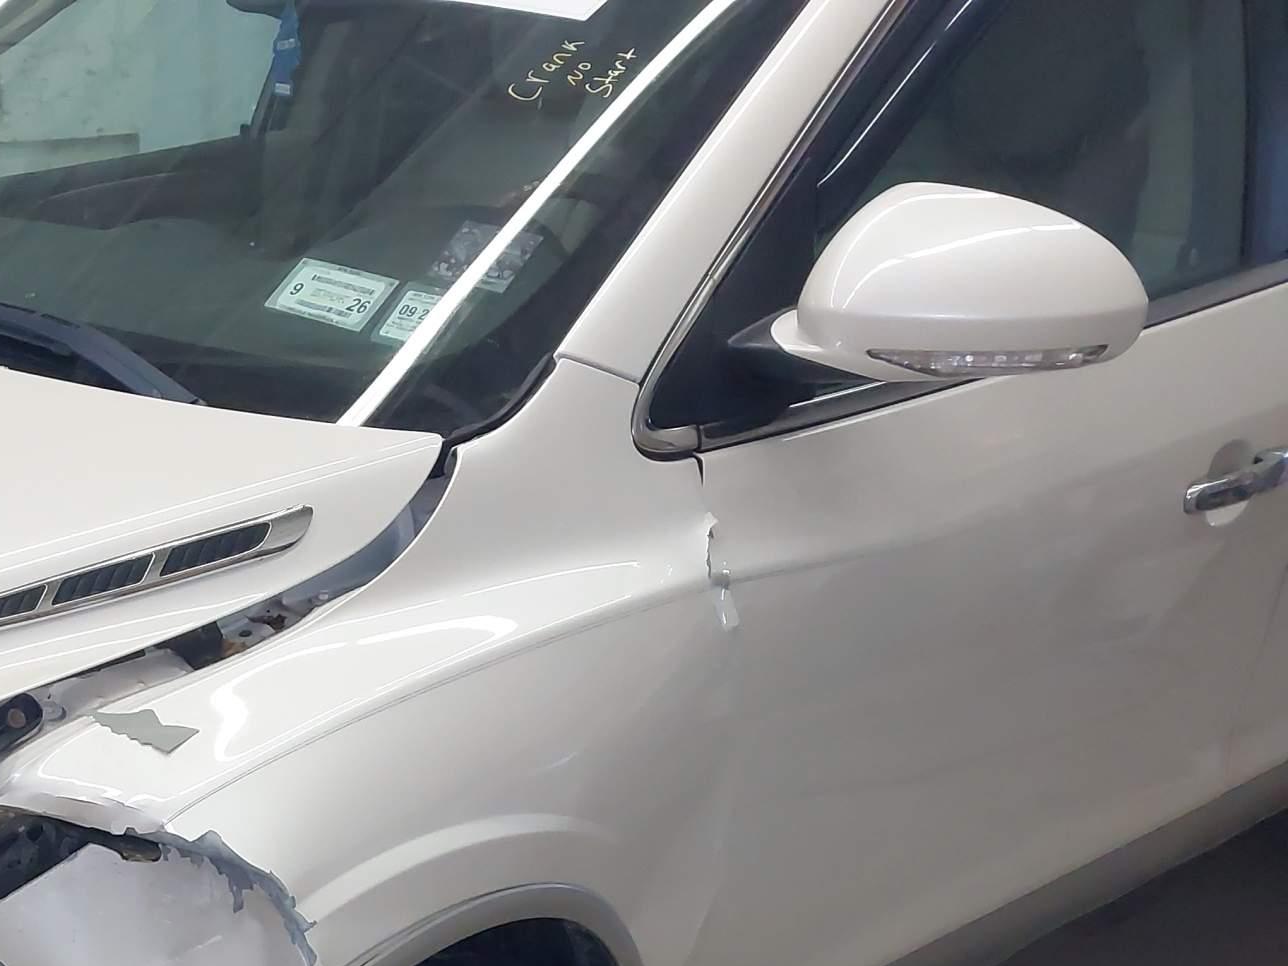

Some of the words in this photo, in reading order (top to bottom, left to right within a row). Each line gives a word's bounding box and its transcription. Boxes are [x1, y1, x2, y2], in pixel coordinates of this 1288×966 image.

[508, 40, 585, 101] Crank
[585, 48, 637, 98] Start
[289, 282, 305, 296] 9
[345, 298, 371, 314] 26
